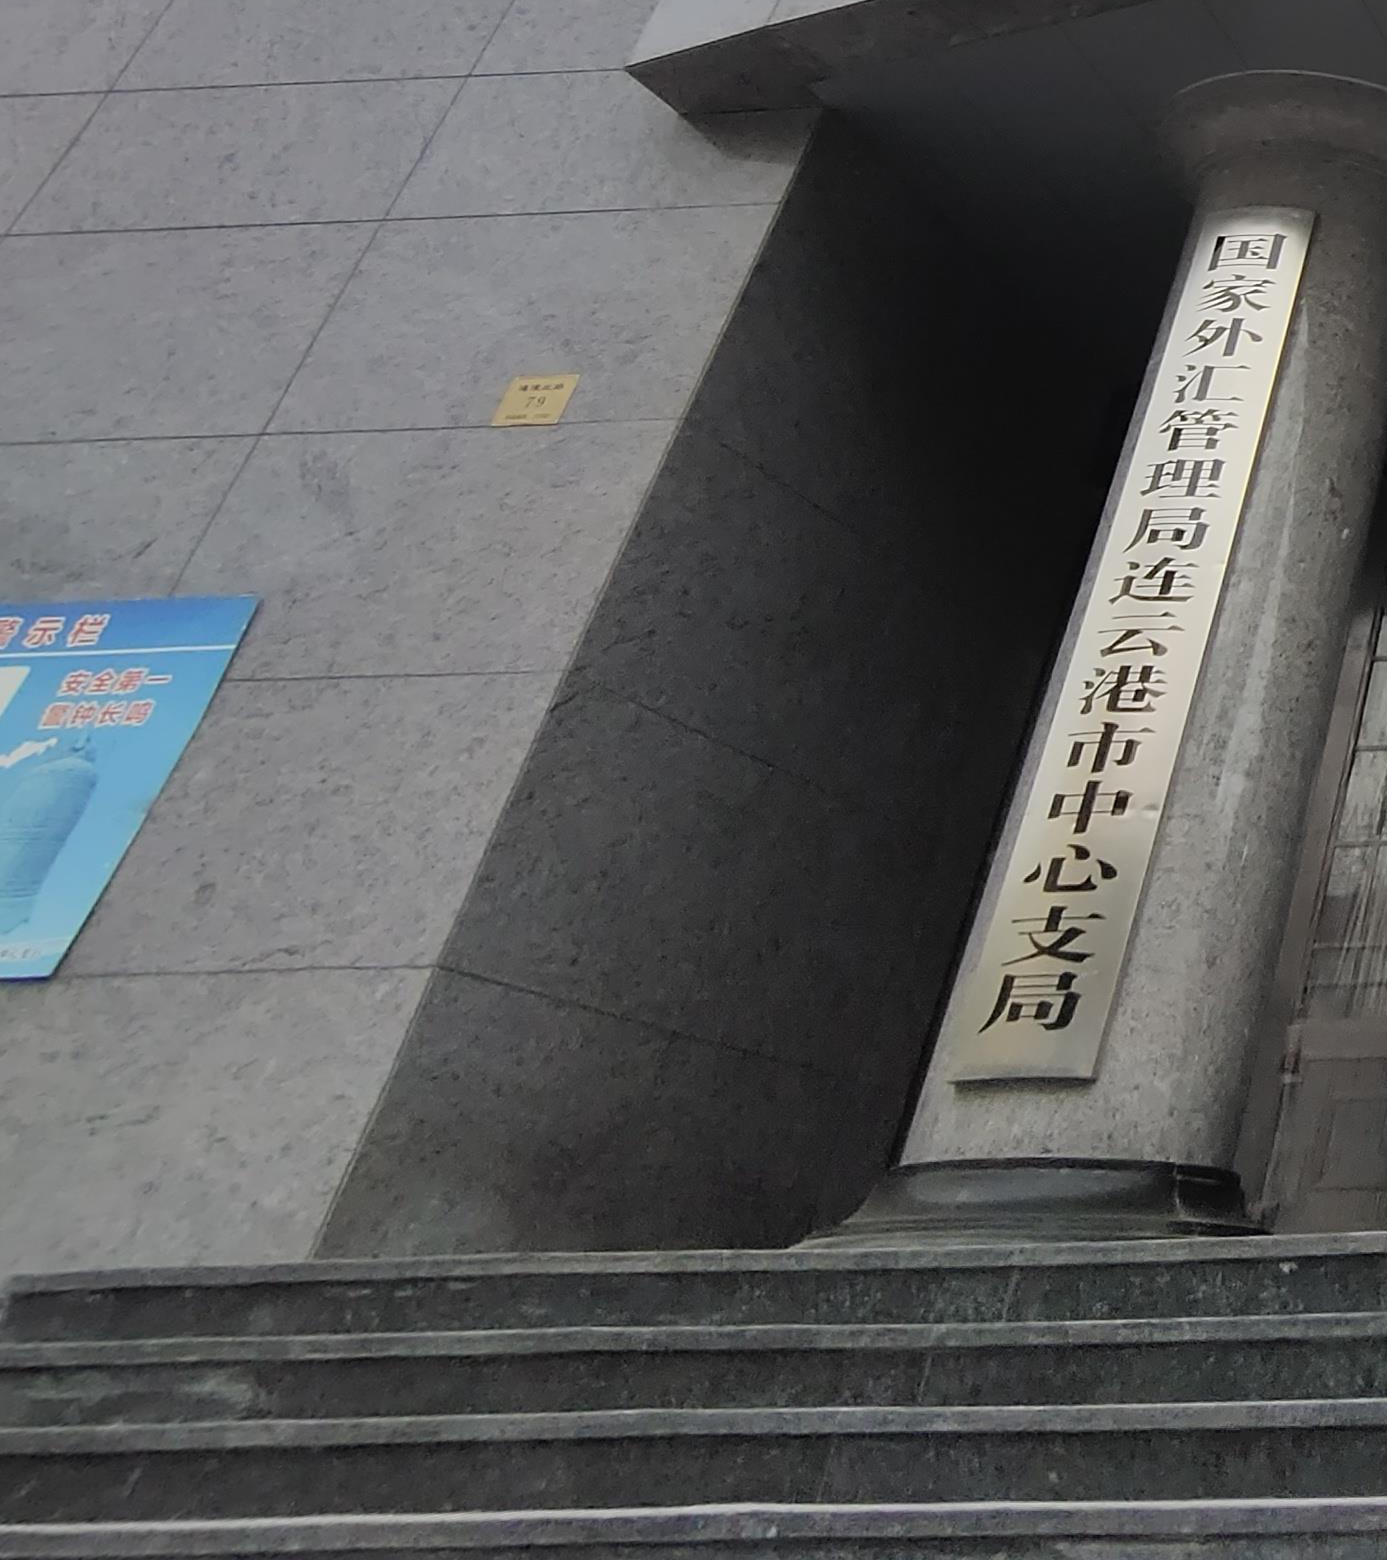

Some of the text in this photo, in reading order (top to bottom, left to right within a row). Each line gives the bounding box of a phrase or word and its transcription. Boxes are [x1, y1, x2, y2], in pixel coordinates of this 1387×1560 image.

[57, 668, 172, 696] 安全第一
[979, 231, 1288, 1035] 国家外汇管理局连云港市中心支局
